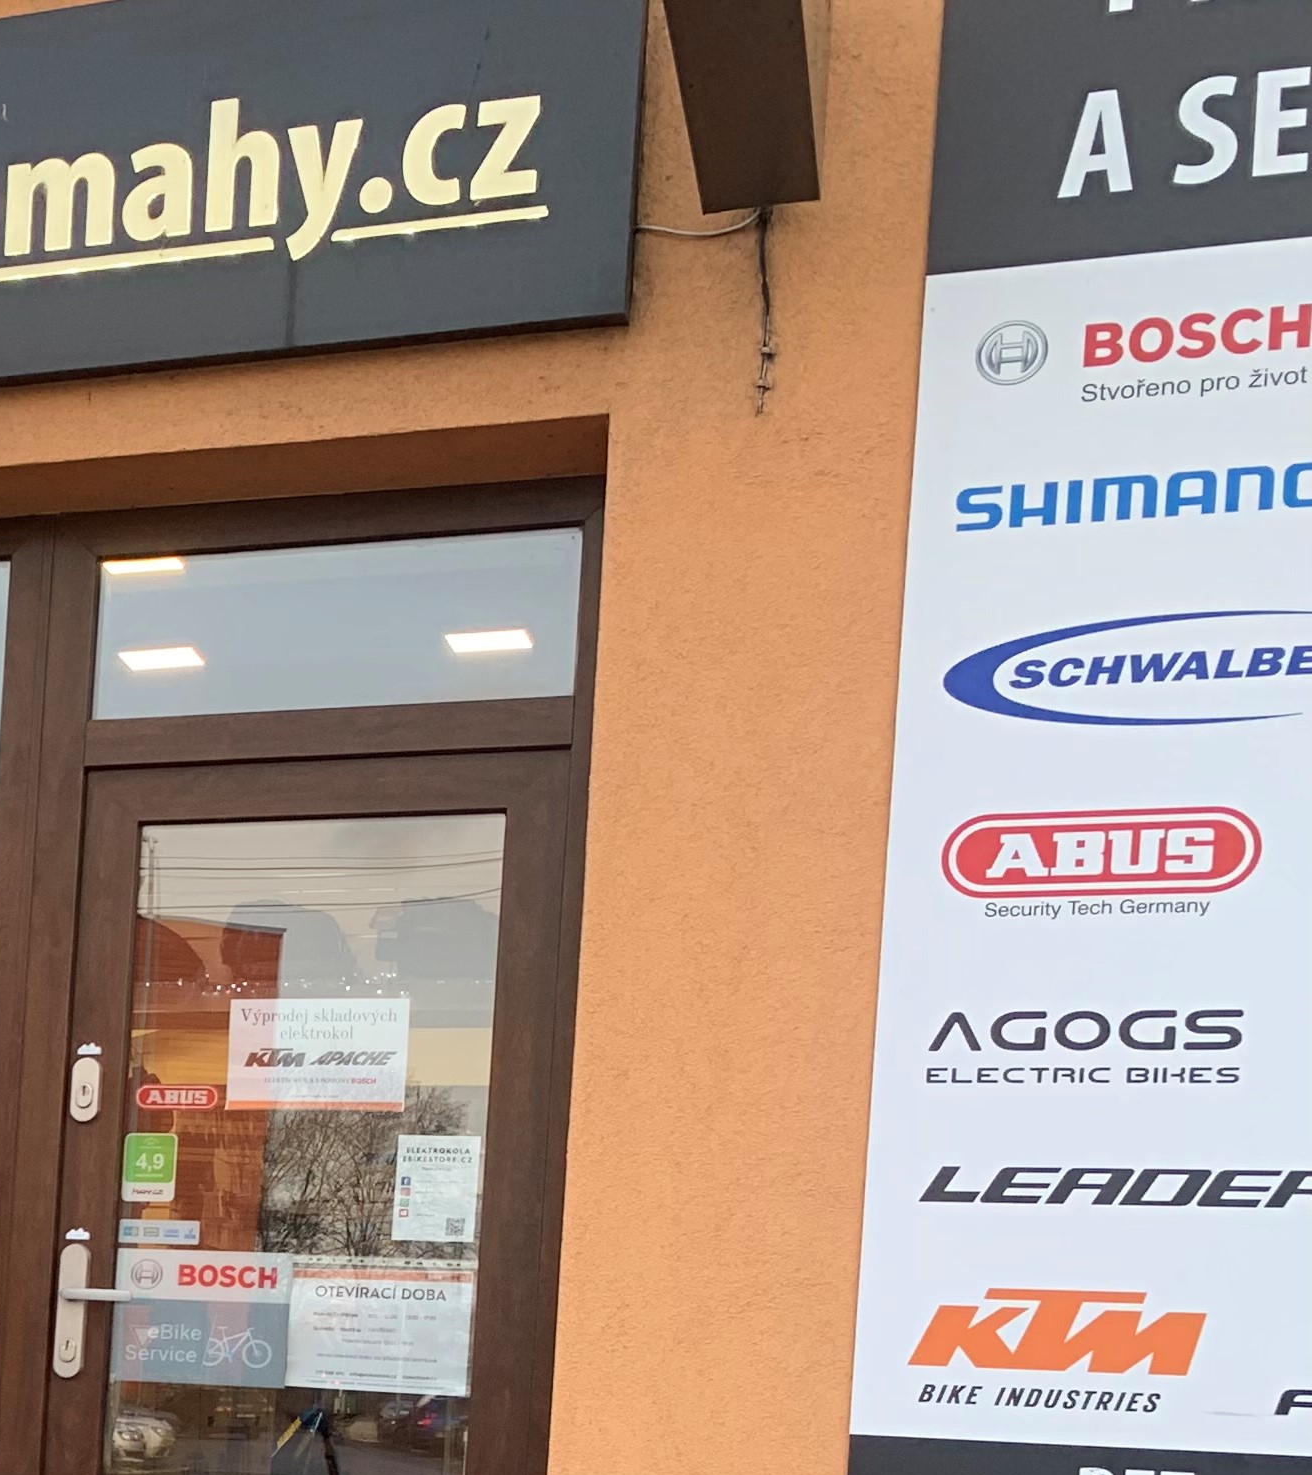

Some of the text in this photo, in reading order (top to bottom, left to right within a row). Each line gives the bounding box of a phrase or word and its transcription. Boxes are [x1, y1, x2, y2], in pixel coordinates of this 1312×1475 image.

[1057, 66, 1312, 199] A SE
[1082, 304, 1312, 368] BOSCH
[1081, 366, 1308, 402] Stvořeno pro život
[1008, 645, 1312, 690] SCHWALBE
[984, 827, 1215, 879] ABUS
[984, 898, 1211, 920] Security Tech Germany
[240, 1007, 397, 1026] Výprodej skladových
[279, 1026, 354, 1041] elektrokol
[928, 1009, 1244, 1052] AGOGS
[244, 1047, 398, 1068] KTM APACHE
[926, 1066, 1240, 1084] ELECTRIC BIKES
[145, 1089, 208, 1105] ABUS
[406, 1147, 471, 1155] ELEKTROKOLA
[135, 1152, 164, 1172] 4,9
[178, 1263, 277, 1290] BOSCH
[315, 1284, 447, 1302] OTEVÍRACÍ DOBA
[147, 1323, 203, 1342] eBike
[907, 1288, 1208, 1377] KTM
[124, 1344, 198, 1363] Service
[918, 1384, 1161, 1413] BIKE INDUSTRIES
